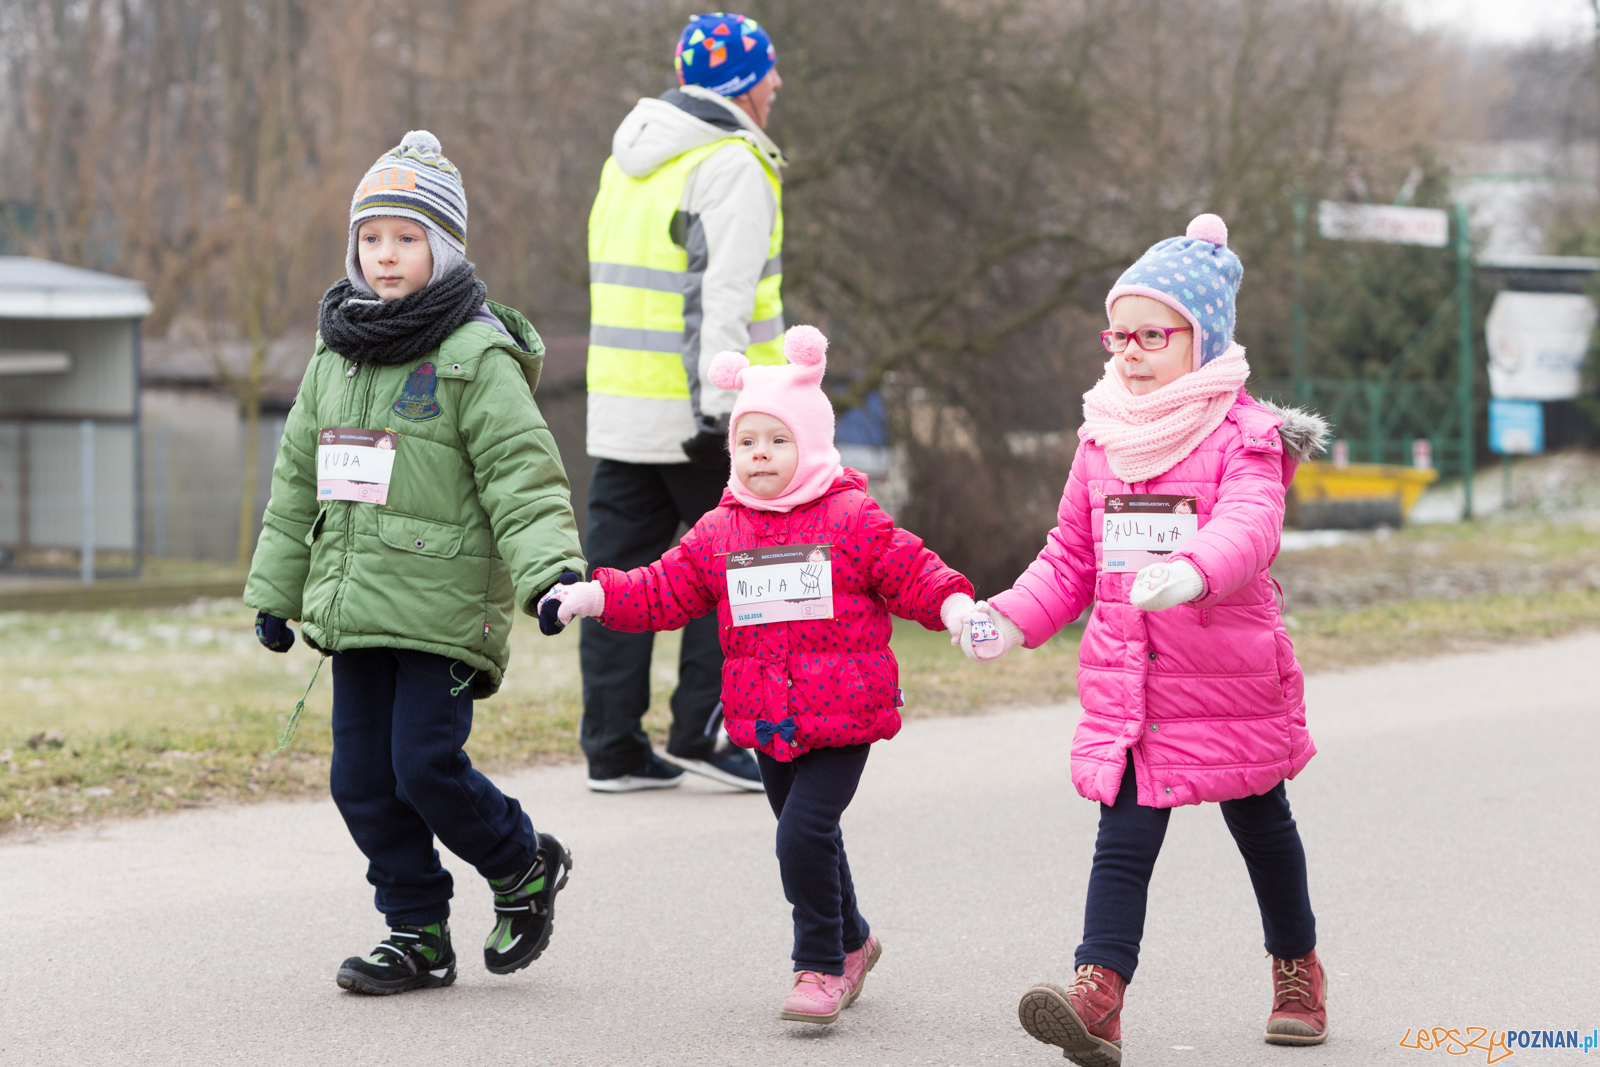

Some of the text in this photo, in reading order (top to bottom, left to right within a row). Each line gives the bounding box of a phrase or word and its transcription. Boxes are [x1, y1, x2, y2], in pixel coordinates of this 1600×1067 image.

[359, 169, 410, 197] FREE
[325, 452, 360, 470] KUBA
[1105, 519, 1182, 543] PAULINA
[737, 578, 787, 597] MISIA
